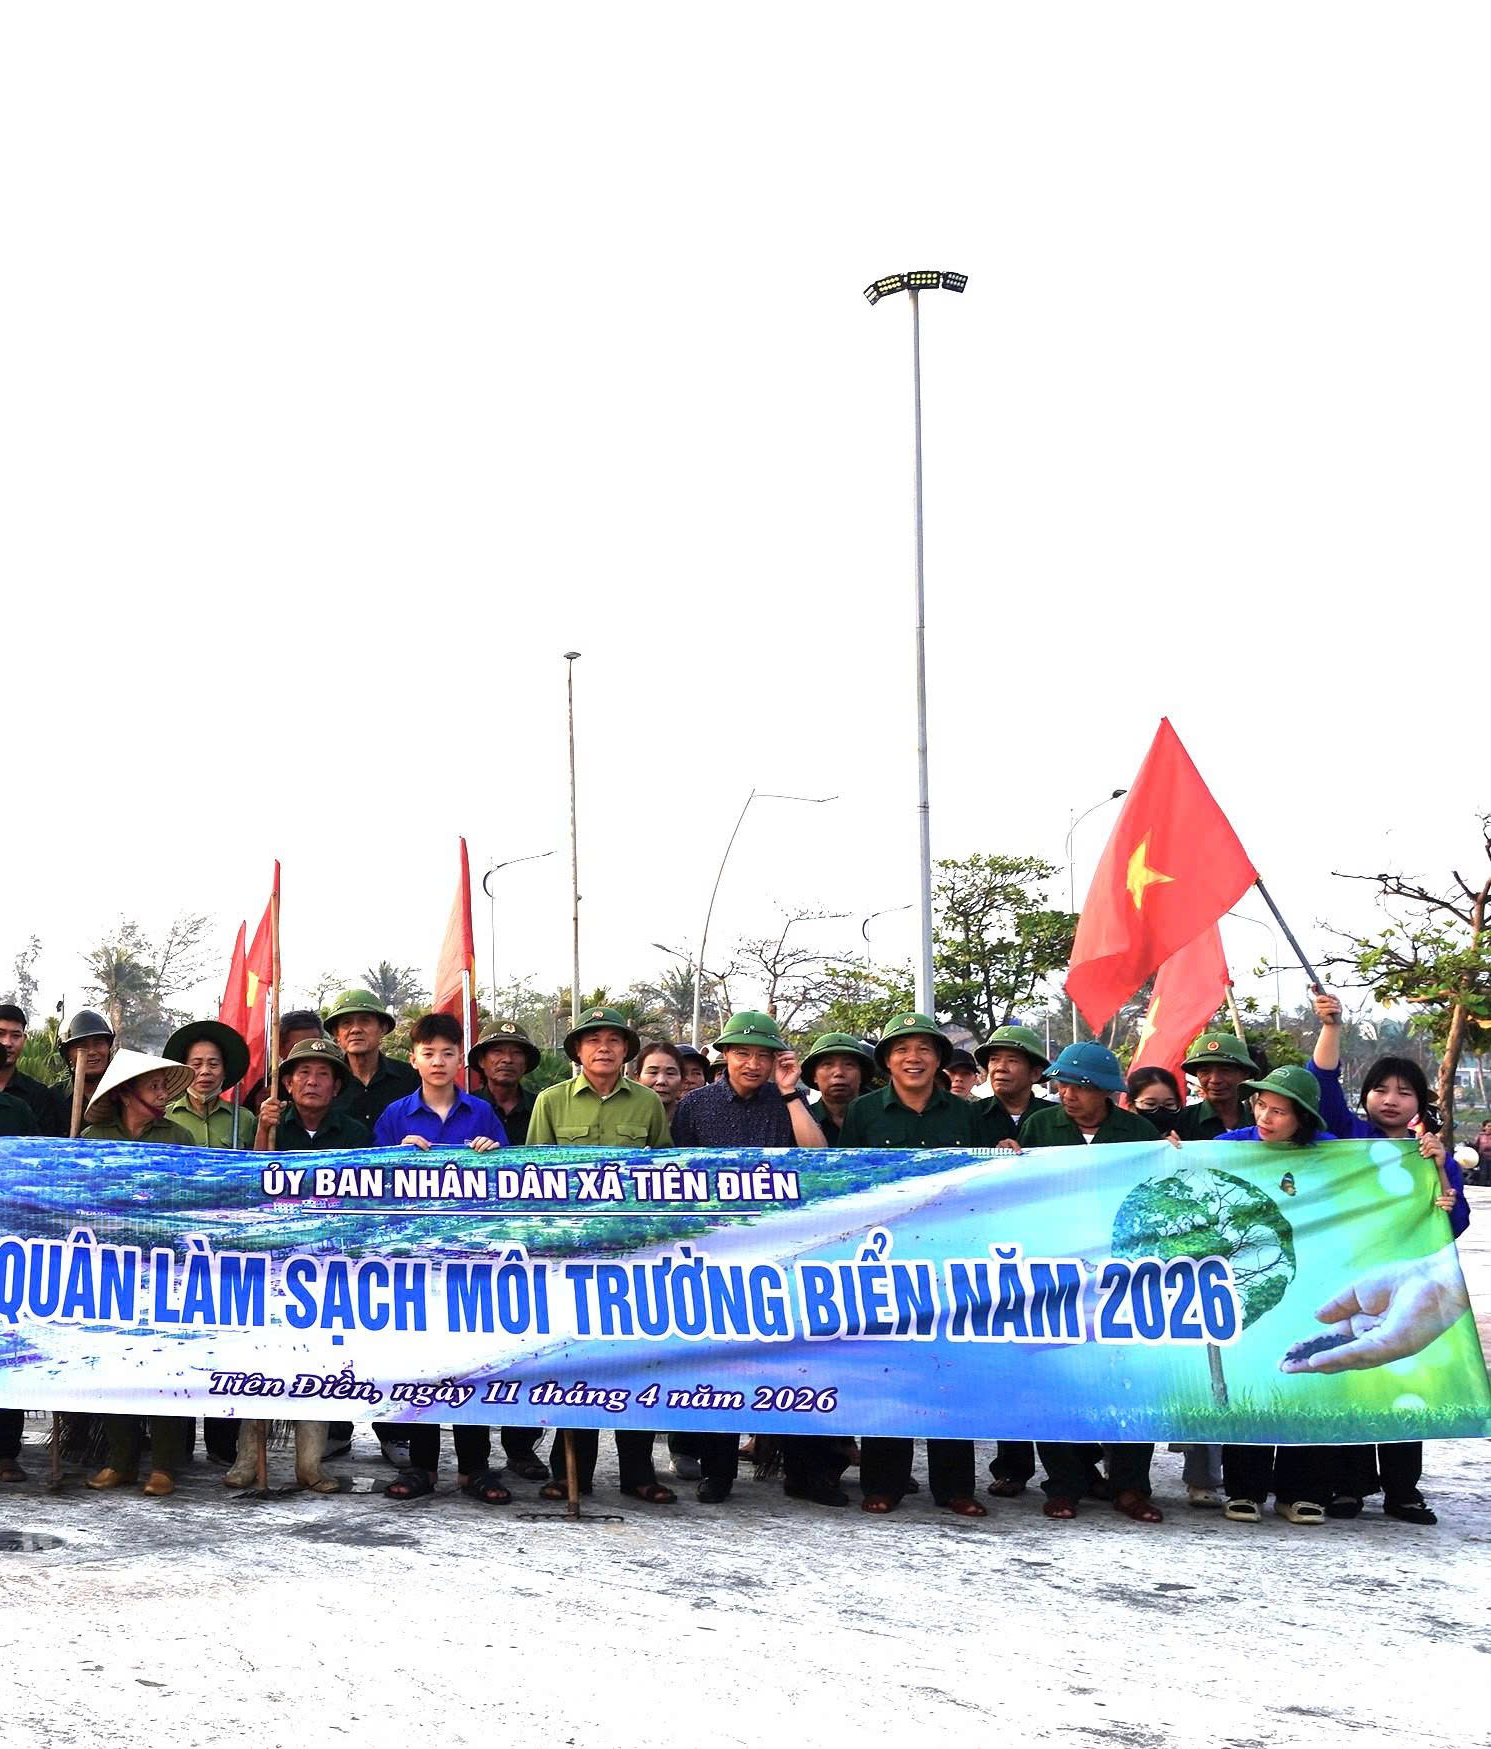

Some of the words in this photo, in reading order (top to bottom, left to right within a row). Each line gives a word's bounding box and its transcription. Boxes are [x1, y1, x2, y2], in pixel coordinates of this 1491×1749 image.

[262, 1163, 306, 1196] ỦY
[315, 1168, 383, 1198] BAN
[394, 1163, 487, 1199] NHÂN
[497, 1164, 567, 1200] DÂN
[577, 1164, 625, 1200] XÃ
[632, 1165, 709, 1201] TIÊN
[717, 1162, 799, 1201] ĐIỀN
[154, 1238, 266, 1327] LÀM
[284, 1257, 428, 1346] SẠCH
[445, 1248, 551, 1335] MÔI
[564, 1246, 790, 1338] TRƯỜNG
[799, 1231, 936, 1338] BIỂN
[949, 1246, 1082, 1339] NĂM
[1098, 1259, 1237, 1341] 2026
[211, 1372, 284, 1396] Tiên
[290, 1370, 383, 1404] Điền,
[392, 1381, 475, 1407] ngày
[485, 1381, 519, 1404] 11
[530, 1382, 629, 1411] tháng
[638, 1385, 660, 1407] 4
[667, 1385, 744, 1409] năm
[753, 1387, 837, 1412] 2026
